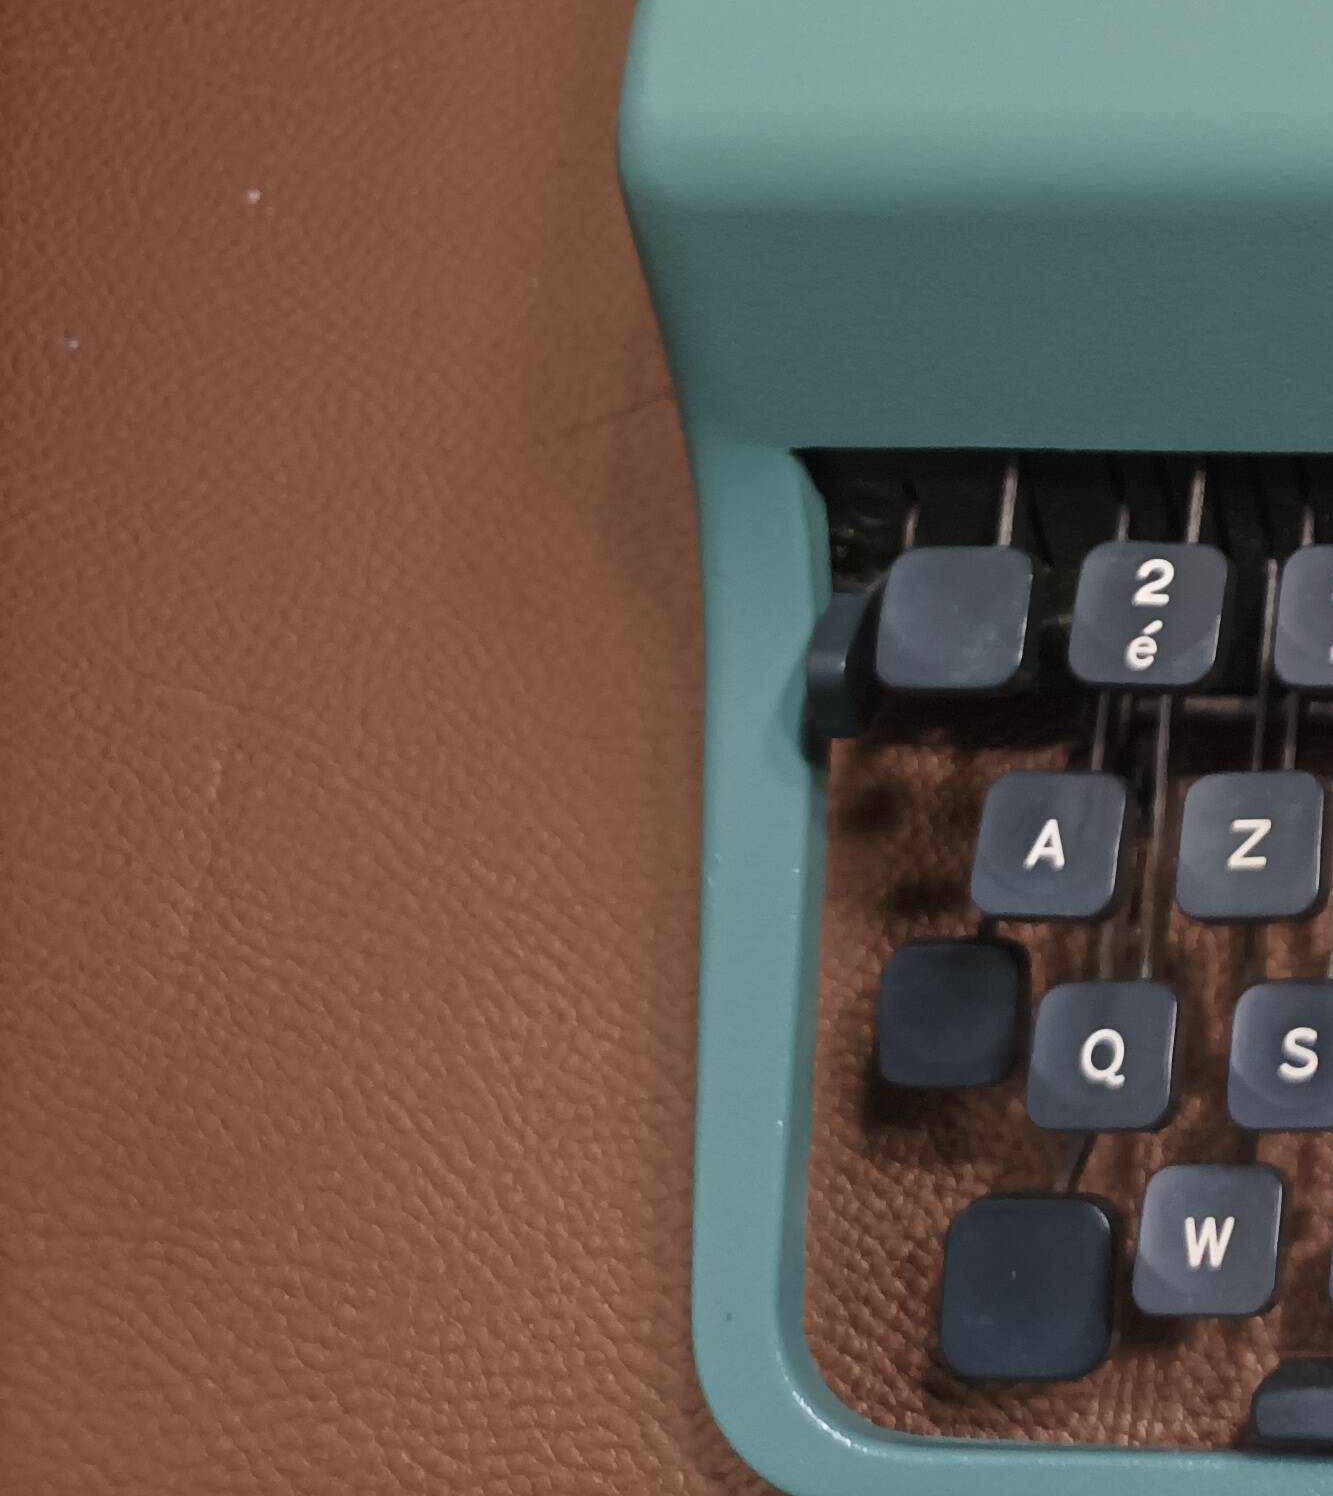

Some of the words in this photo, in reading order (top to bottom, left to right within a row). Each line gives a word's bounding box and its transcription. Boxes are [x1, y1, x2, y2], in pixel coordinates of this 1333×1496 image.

[1132, 559, 1175, 606] 2
[1124, 620, 1163, 670] é
[1023, 819, 1065, 871] A
[1226, 819, 1272, 871] Z
[1081, 1028, 1126, 1089] Q
[1277, 1026, 1319, 1082] S
[1183, 1216, 1235, 1270] W
